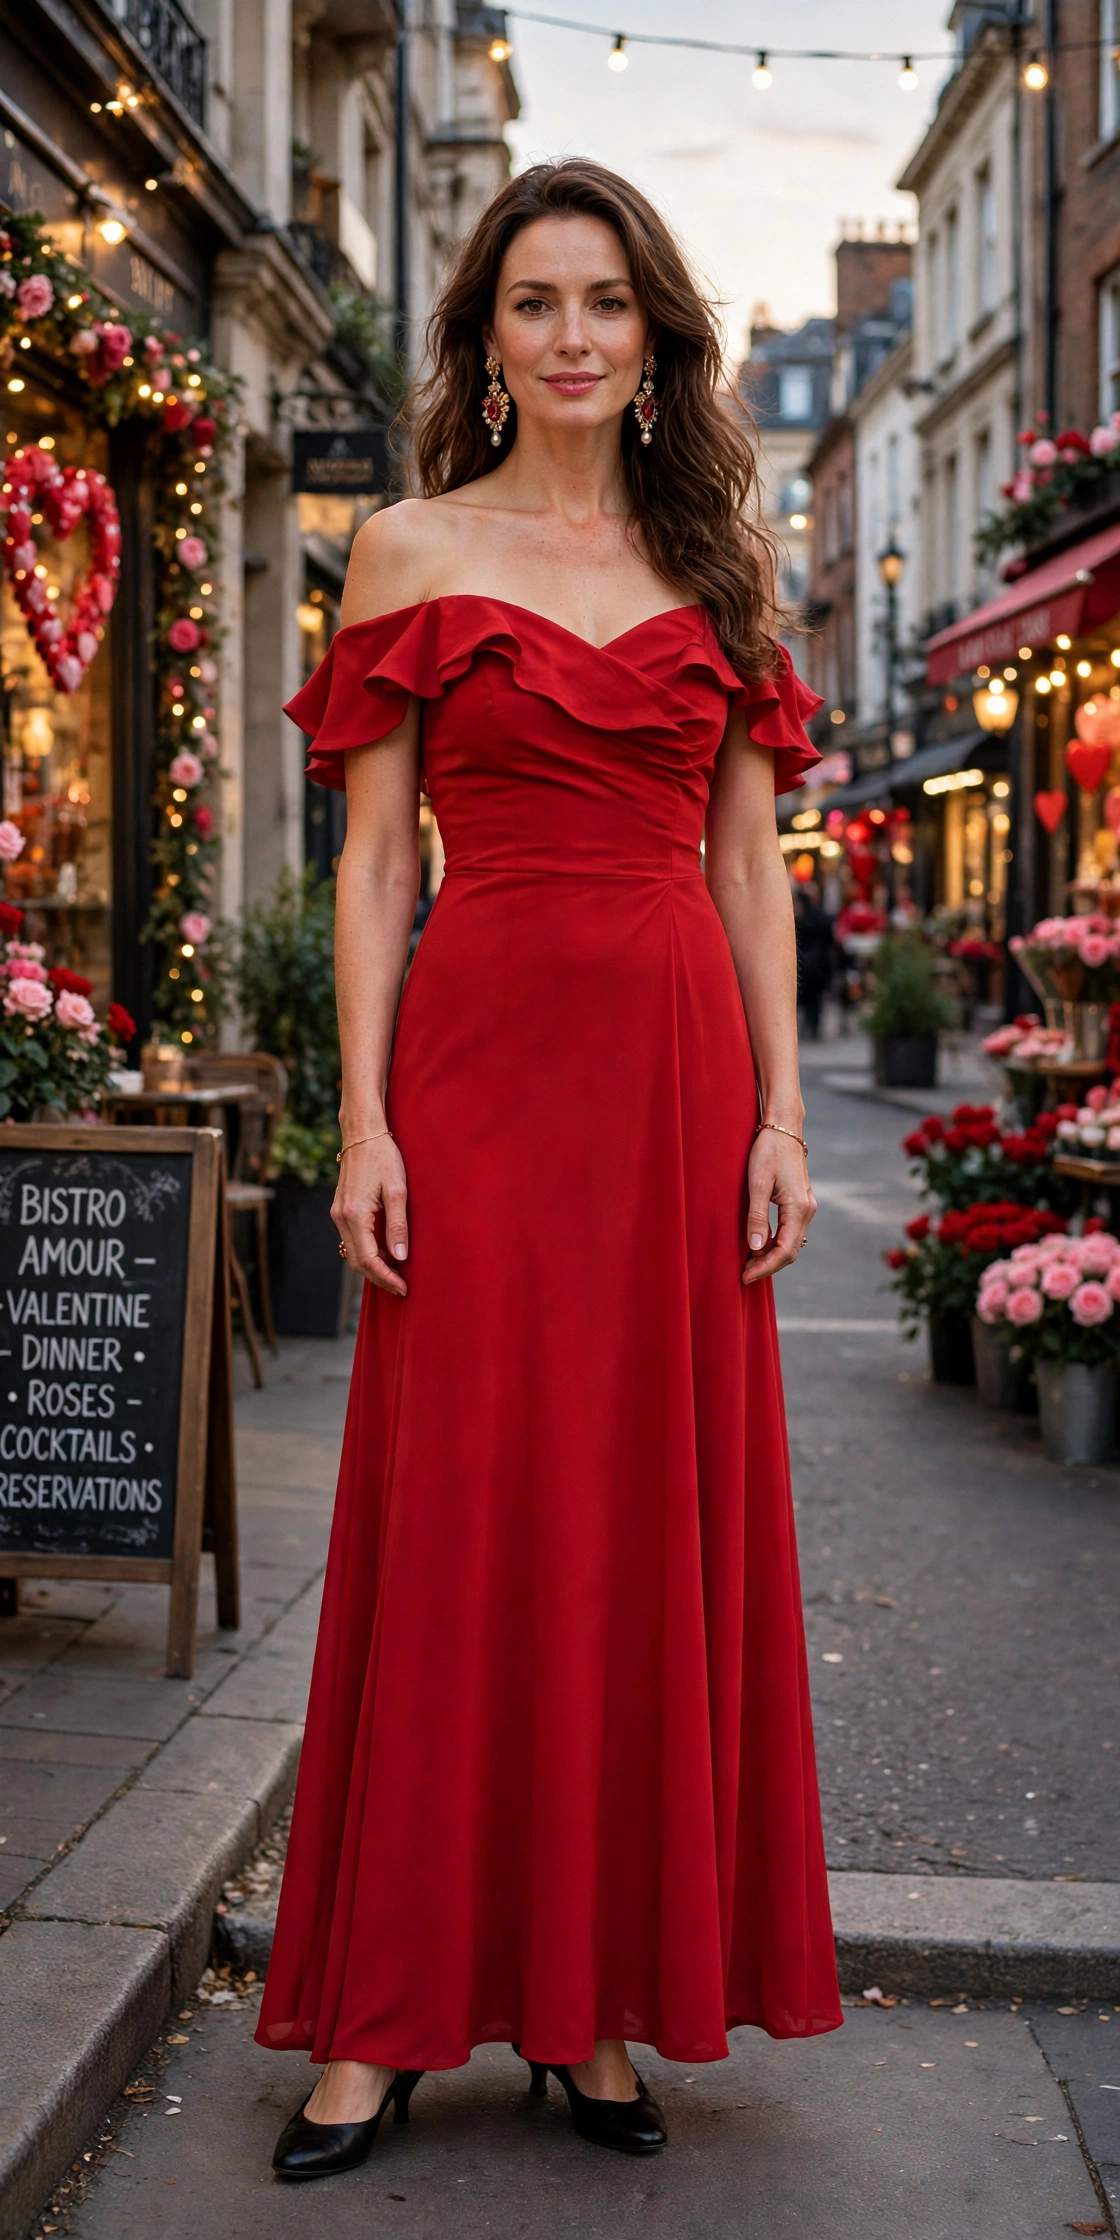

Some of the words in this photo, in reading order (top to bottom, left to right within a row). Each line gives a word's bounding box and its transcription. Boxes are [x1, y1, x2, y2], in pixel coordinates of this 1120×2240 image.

[21, 1184, 126, 1227] BISTRO
[18, 1236, 125, 1278] AMOUR
[7, 1289, 150, 1327] VALENTINE
[22, 1334, 122, 1372] DINNER
[28, 1380, 114, 1418] ROSES
[1, 1425, 136, 1463] COCKTAILS
